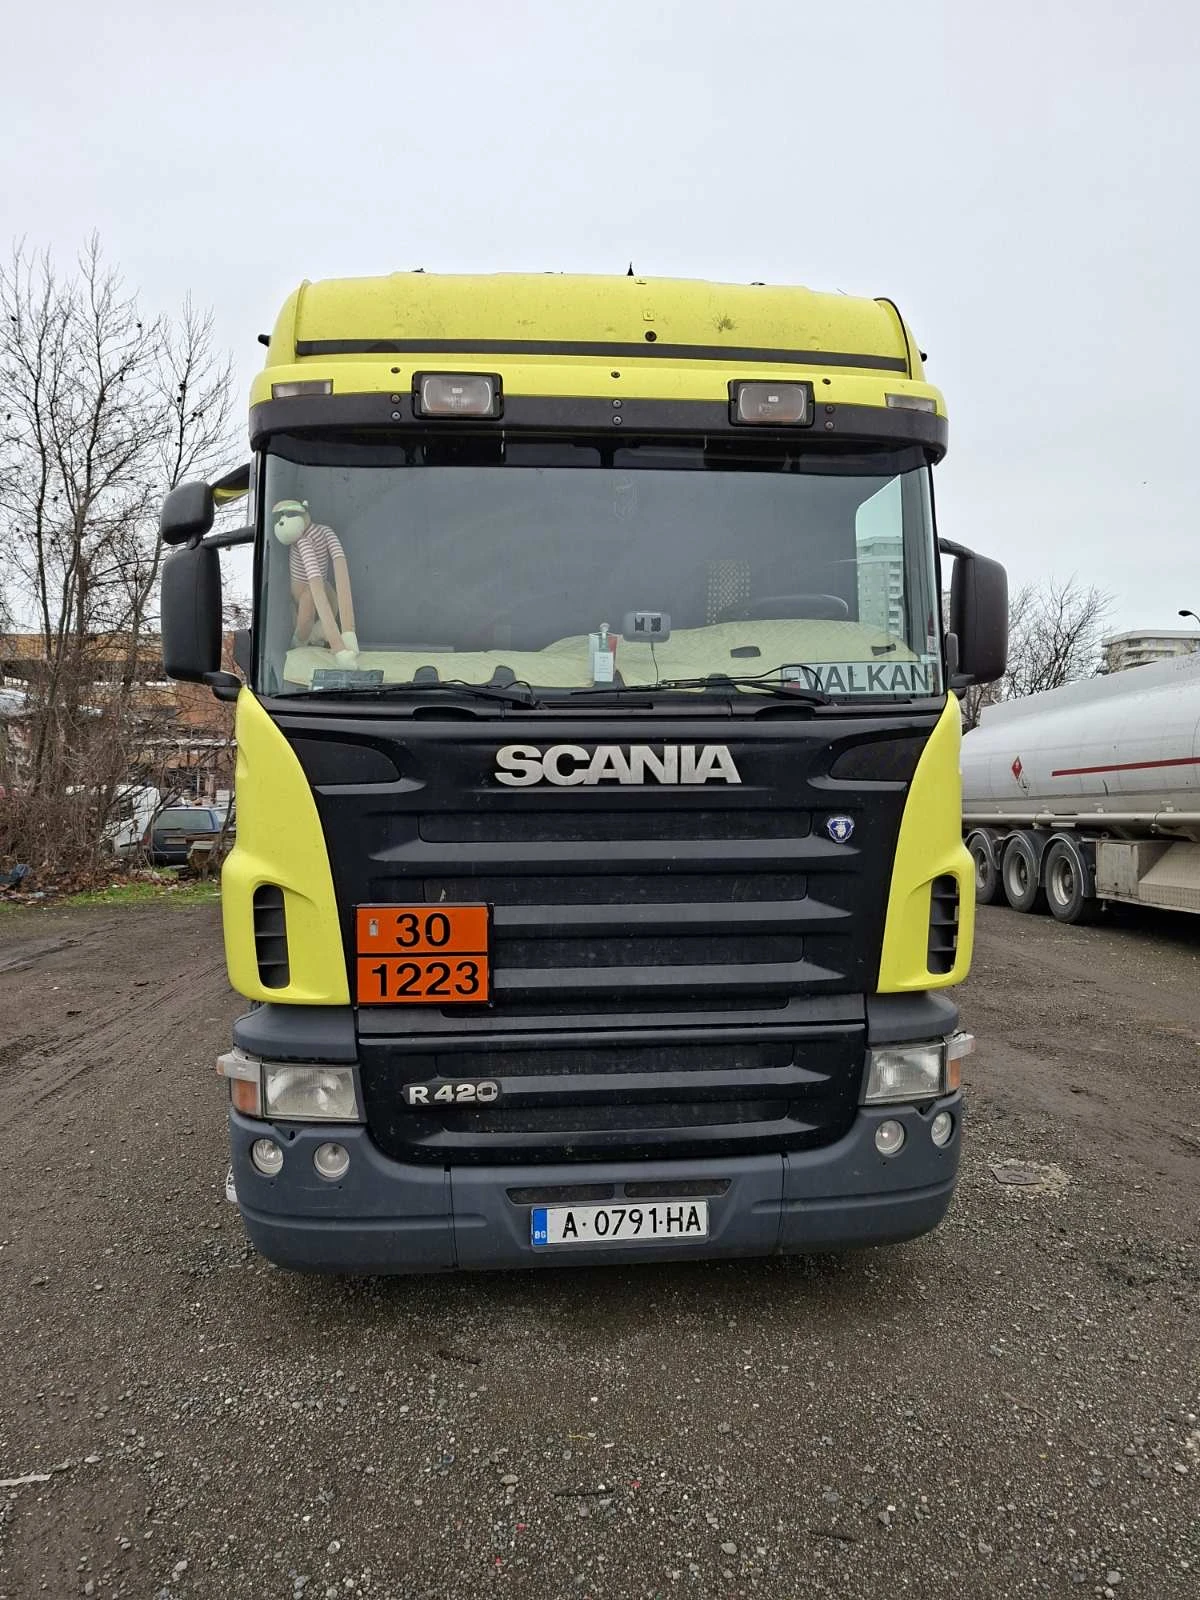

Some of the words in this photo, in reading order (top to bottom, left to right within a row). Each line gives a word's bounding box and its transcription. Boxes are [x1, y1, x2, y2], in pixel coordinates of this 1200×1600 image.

[801, 664, 930, 693] VALKAN
[494, 744, 742, 786] SCANIA
[395, 912, 451, 948] 30
[371, 960, 480, 997] 1223
[409, 1086, 430, 1105] R
[434, 1081, 498, 1103] 420
[534, 1230, 547, 1239] BG
